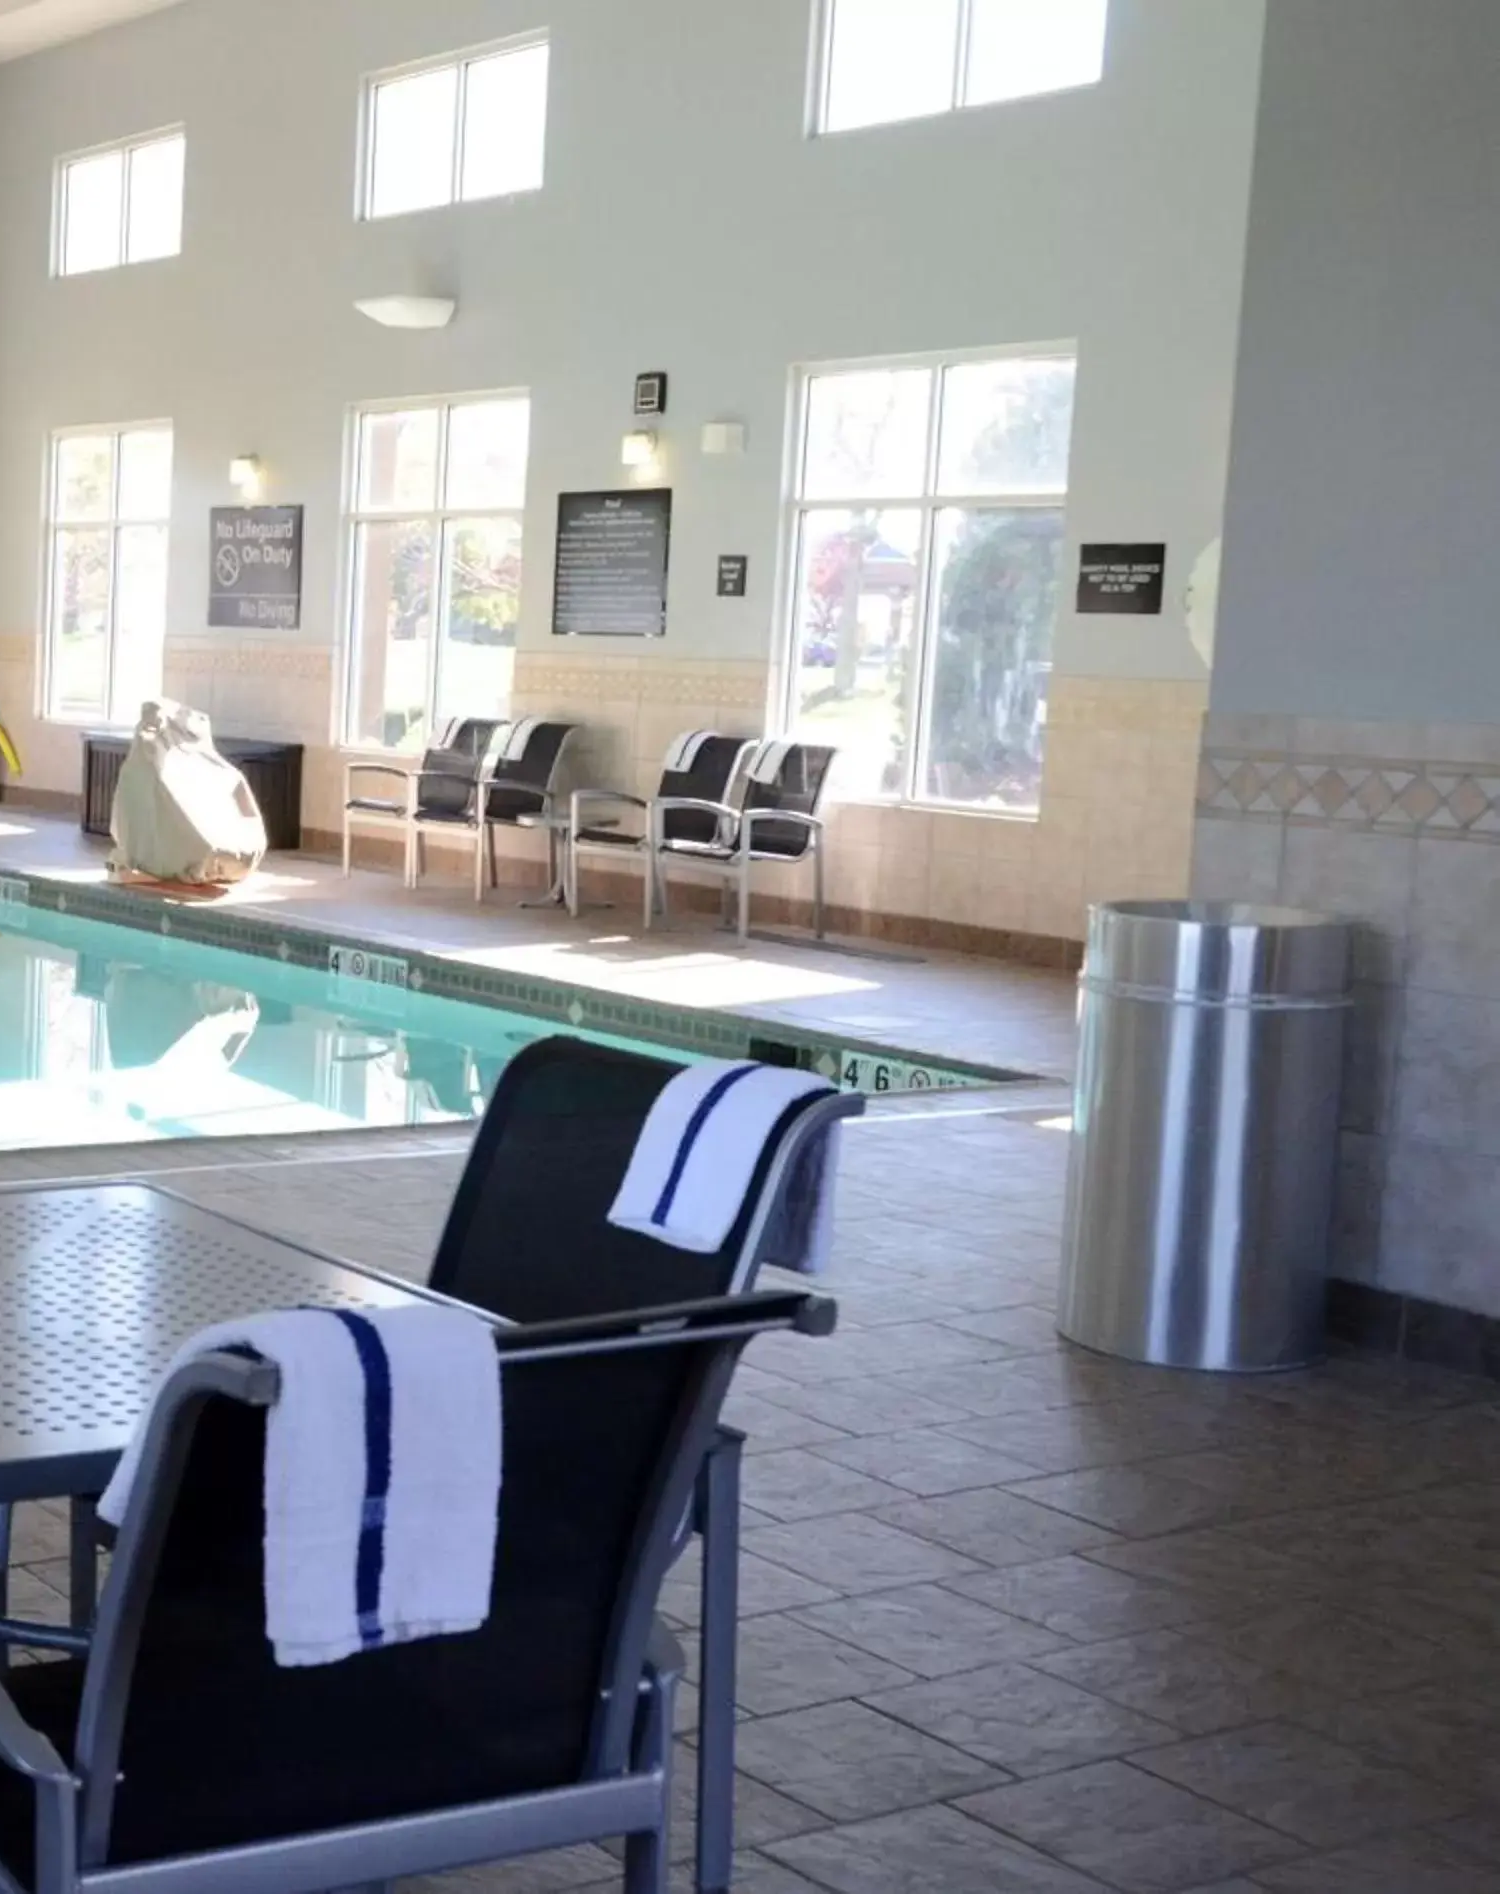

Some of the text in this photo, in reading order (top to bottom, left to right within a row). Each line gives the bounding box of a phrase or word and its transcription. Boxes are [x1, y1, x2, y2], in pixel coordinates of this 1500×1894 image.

[217, 518, 293, 544] No Lifeguard
[242, 545, 293, 568] On Duty
[239, 600, 296, 626] No Diving
[331, 951, 340, 975] 4
[844, 1058, 859, 1089] 4
[875, 1064, 890, 1091] 6
